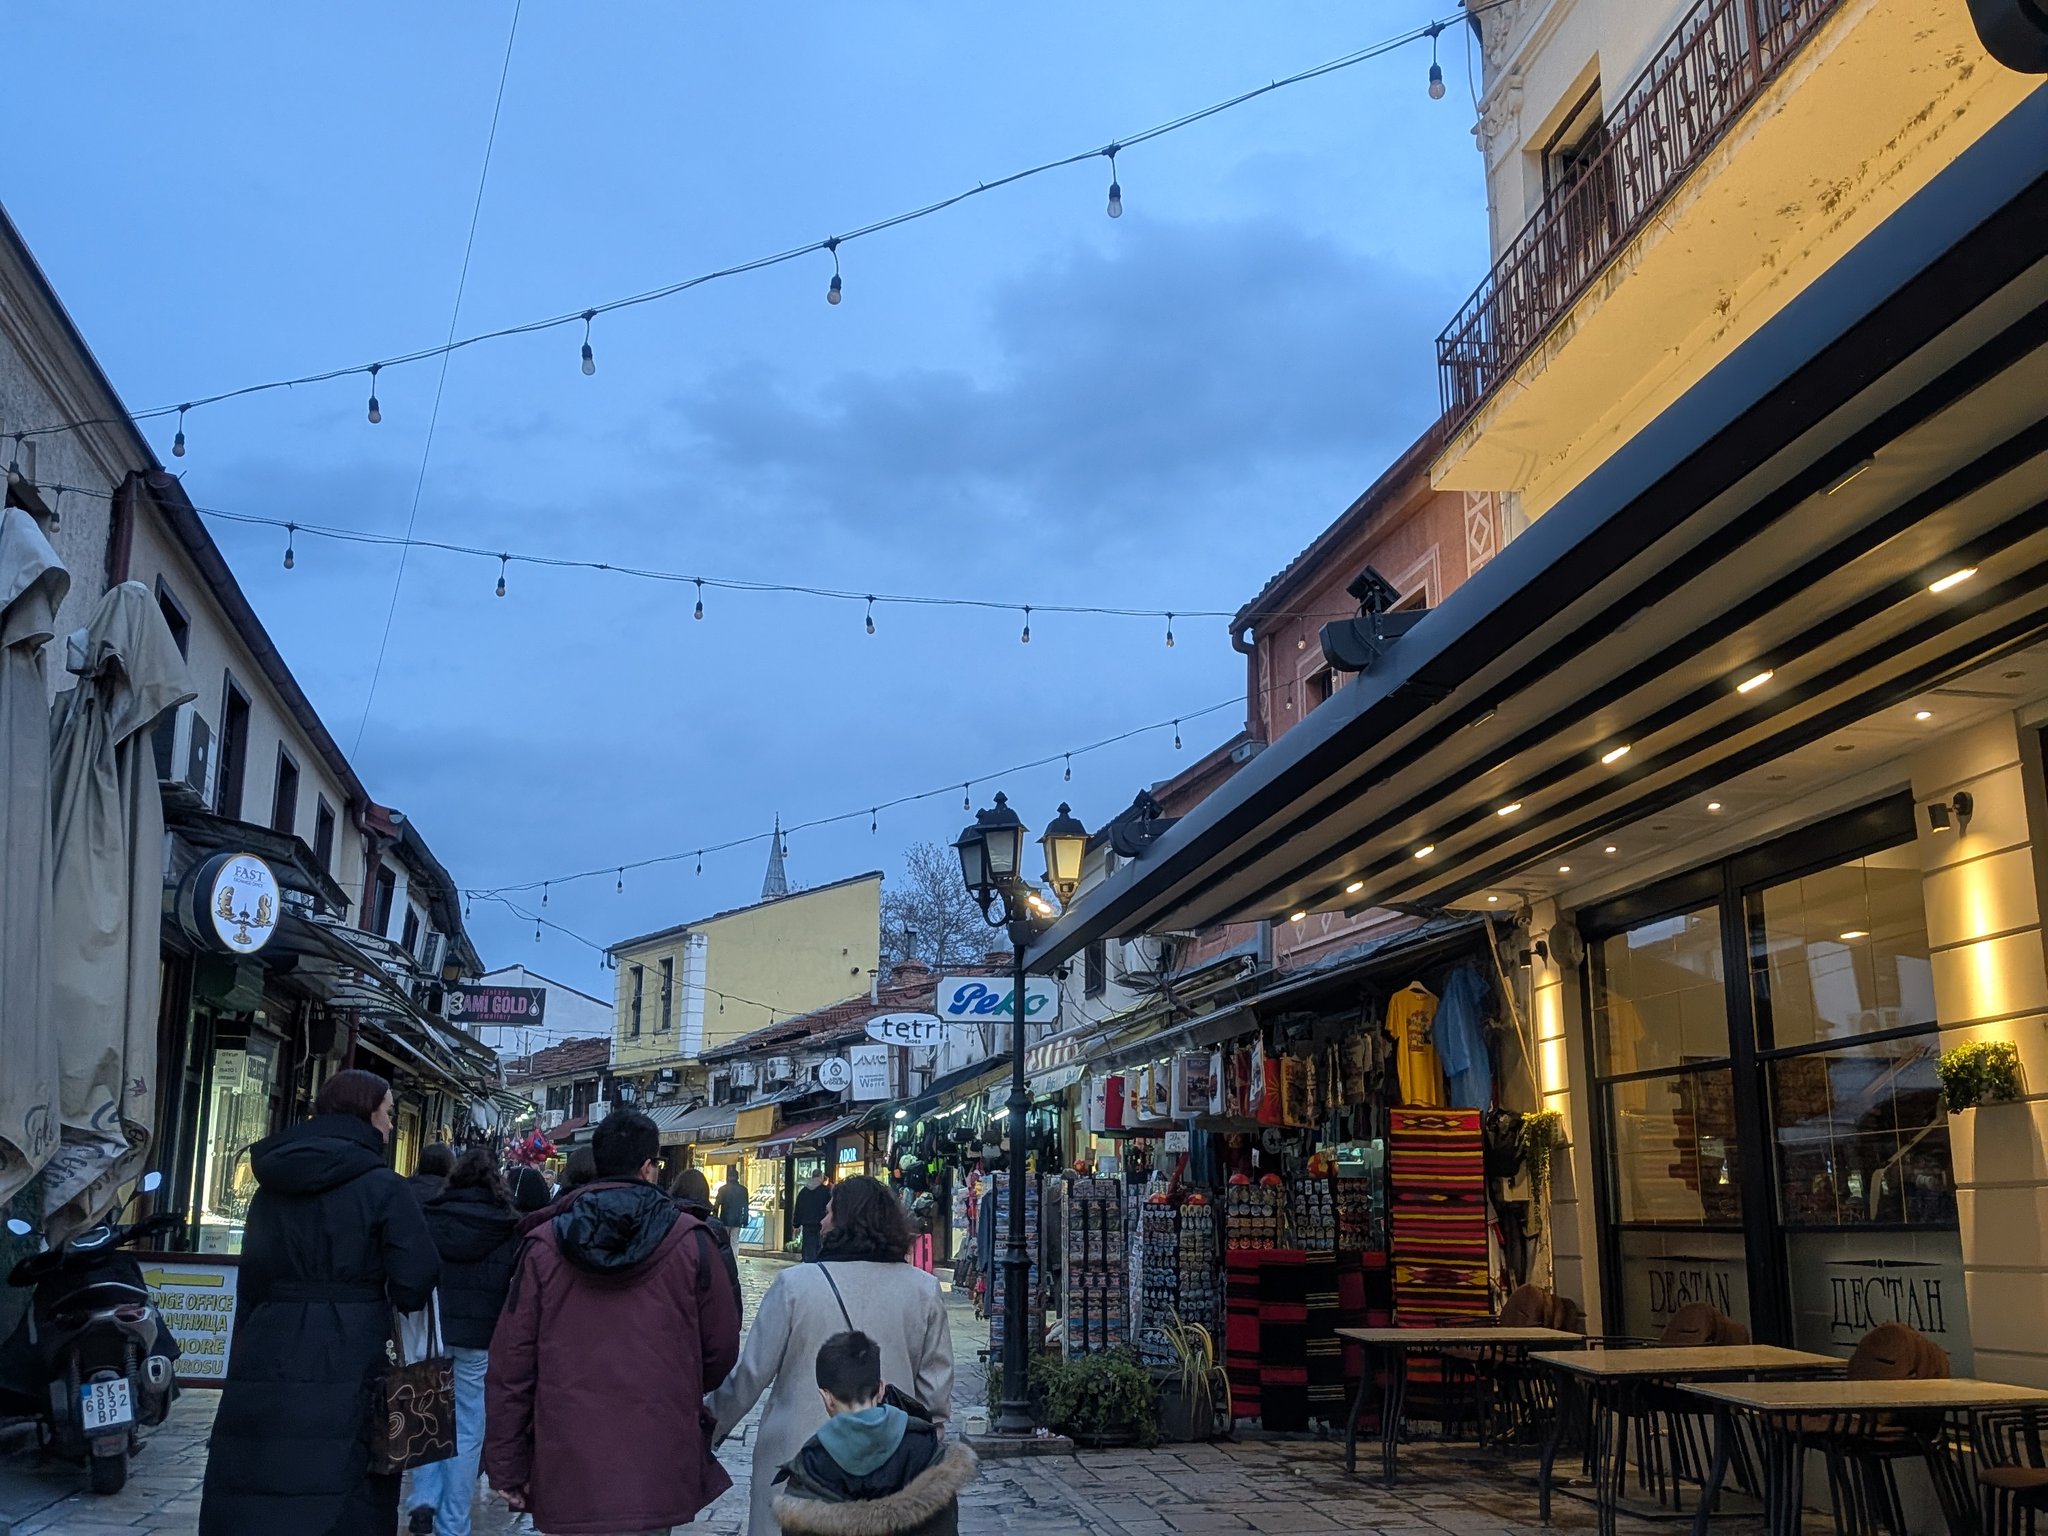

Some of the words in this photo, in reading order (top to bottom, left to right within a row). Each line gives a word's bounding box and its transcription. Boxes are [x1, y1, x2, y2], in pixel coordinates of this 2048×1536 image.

[235, 866, 265, 882] FAST
[492, 995, 528, 1014] GOLD
[948, 982, 1049, 1016] Peko
[839, 1147, 857, 1163] ADOR
[185, 1294, 234, 1312] OFFICE
[1647, 1270, 1731, 1318] DESTAN
[1830, 1276, 1946, 1335] ДЕСТАН
[163, 1312, 228, 1334] АЧНИЦА
[175, 1337, 226, 1355] MORE
[173, 1358, 224, 1375] UROSU
[96, 1383, 116, 1398] SK
[86, 1394, 128, 1413] 6832
[98, 1408, 118, 1424] BP
